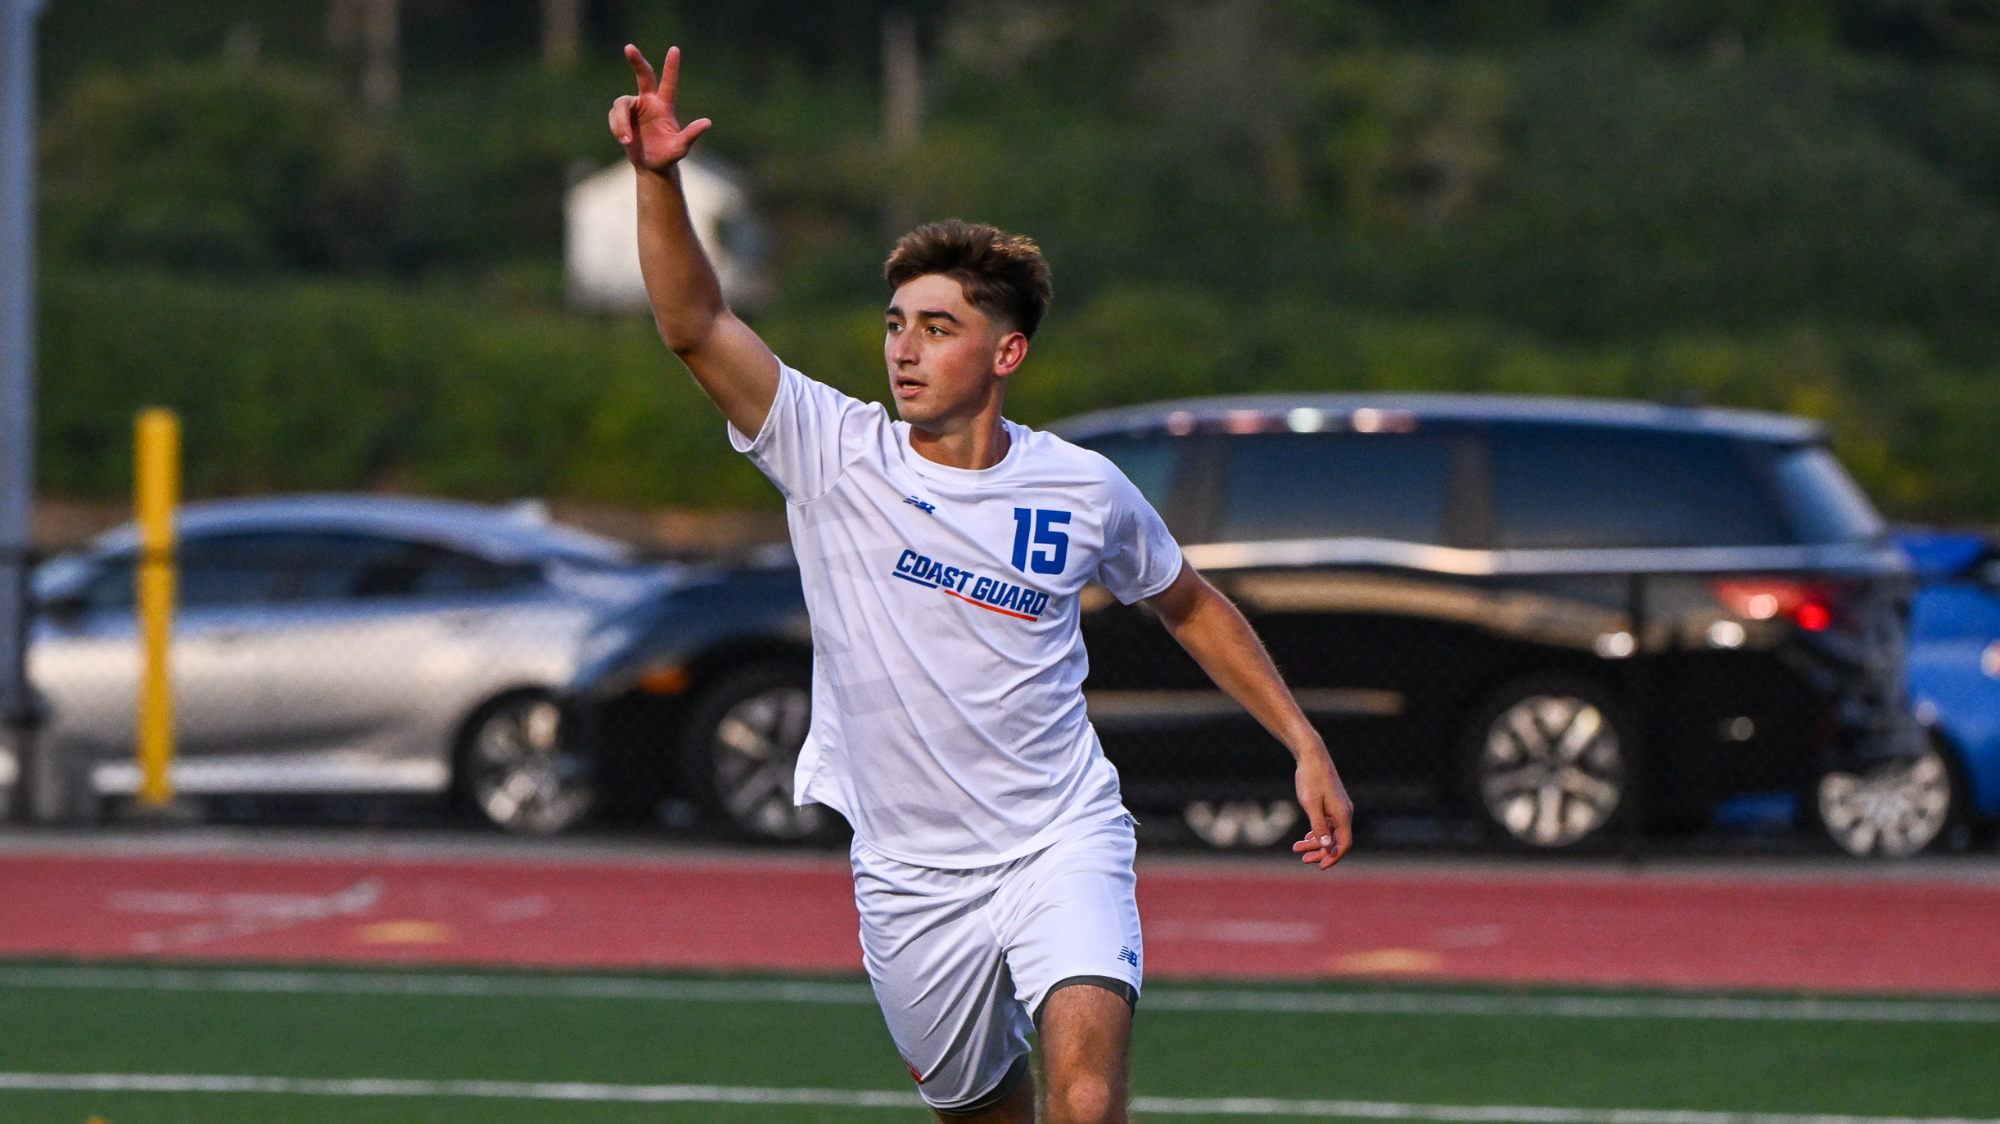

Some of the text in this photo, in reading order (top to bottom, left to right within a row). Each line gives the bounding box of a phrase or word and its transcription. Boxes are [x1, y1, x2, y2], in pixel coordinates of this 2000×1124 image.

[1011, 507, 1072, 576] 15
[895, 549, 1049, 616] COAST GUARD
